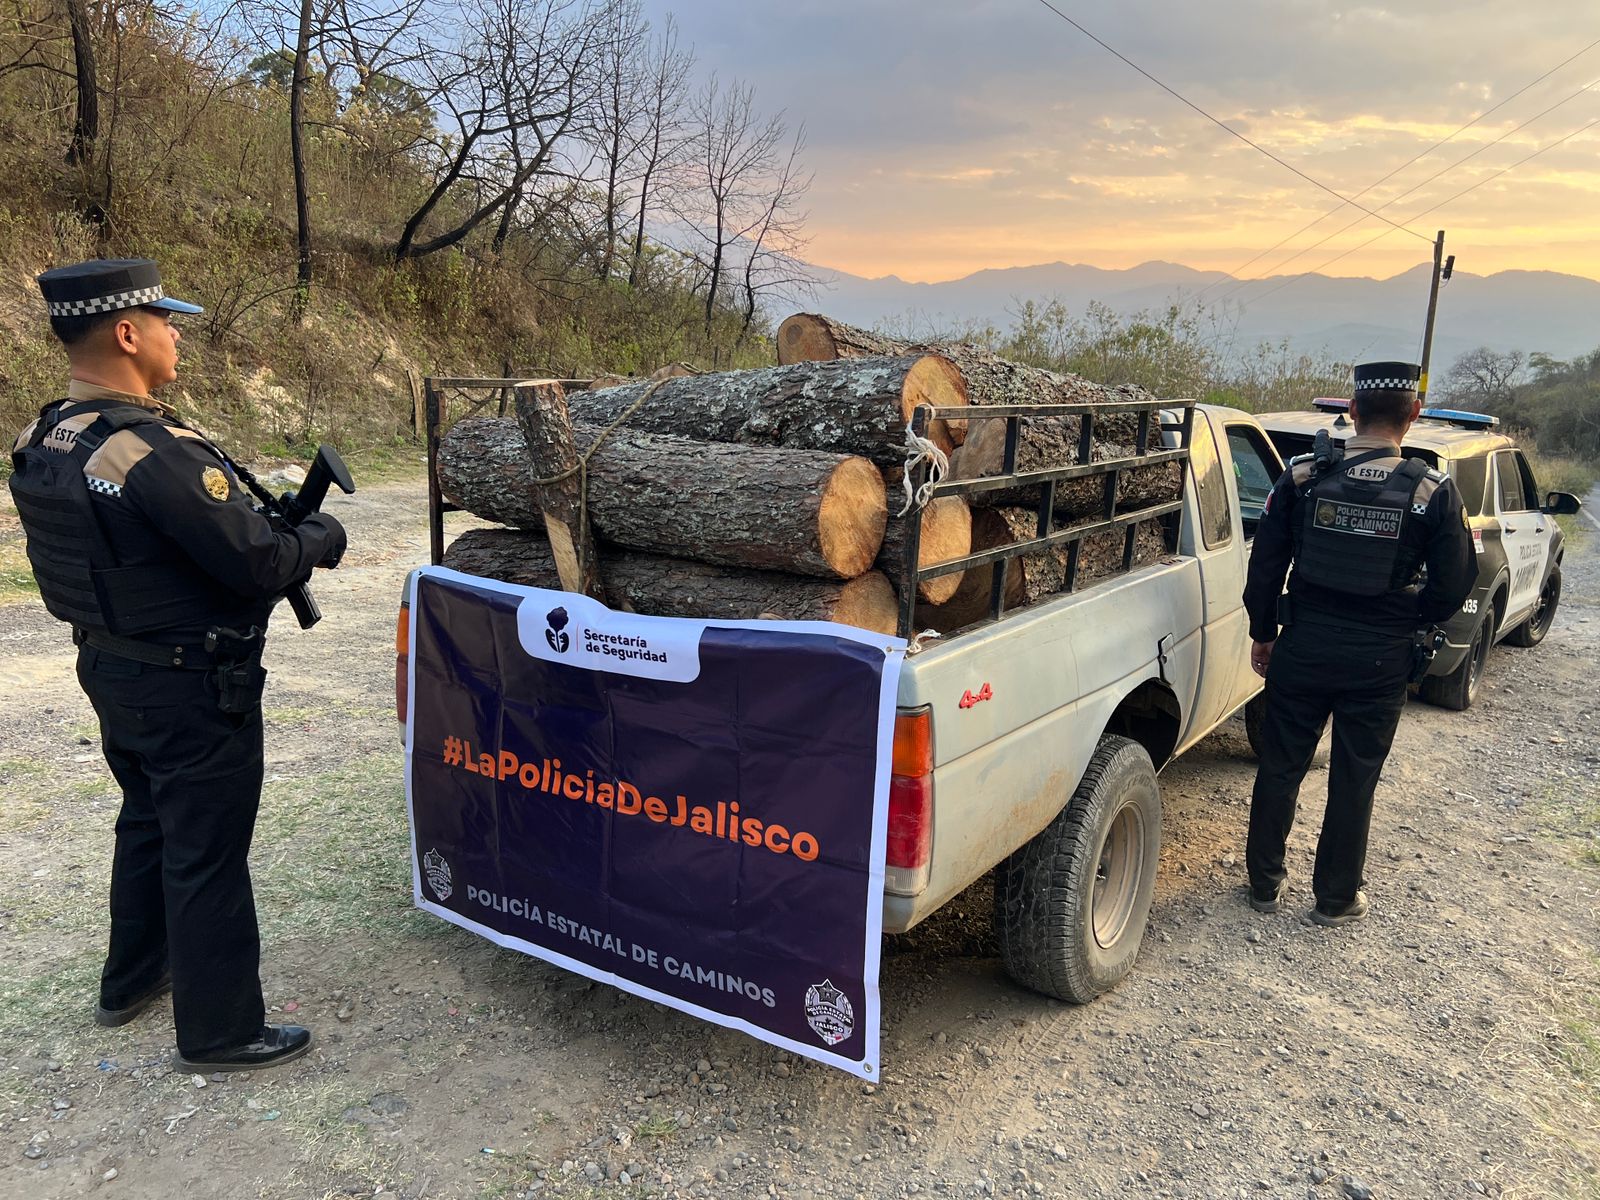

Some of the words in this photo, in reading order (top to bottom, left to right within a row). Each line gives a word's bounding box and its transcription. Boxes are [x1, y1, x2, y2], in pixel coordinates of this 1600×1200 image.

[55, 427, 80, 444] ESTA
[1359, 468, 1391, 480] ESTAT
[1336, 506, 1364, 518] POLICÍA
[1367, 510, 1400, 522] ESTATAL
[1335, 515, 1348, 527] DE
[1350, 518, 1397, 532] CAMINOS
[584, 628, 647, 648] Secretaría
[585, 642, 600, 653] de
[602, 645, 667, 663] Seguridad
[467, 885, 543, 925] POLICÍA
[547, 911, 627, 957] ESTATAL
[631, 943, 659, 969] DE
[663, 956, 776, 1008] CAMINOS
[815, 1021, 844, 1033] JALISCO
